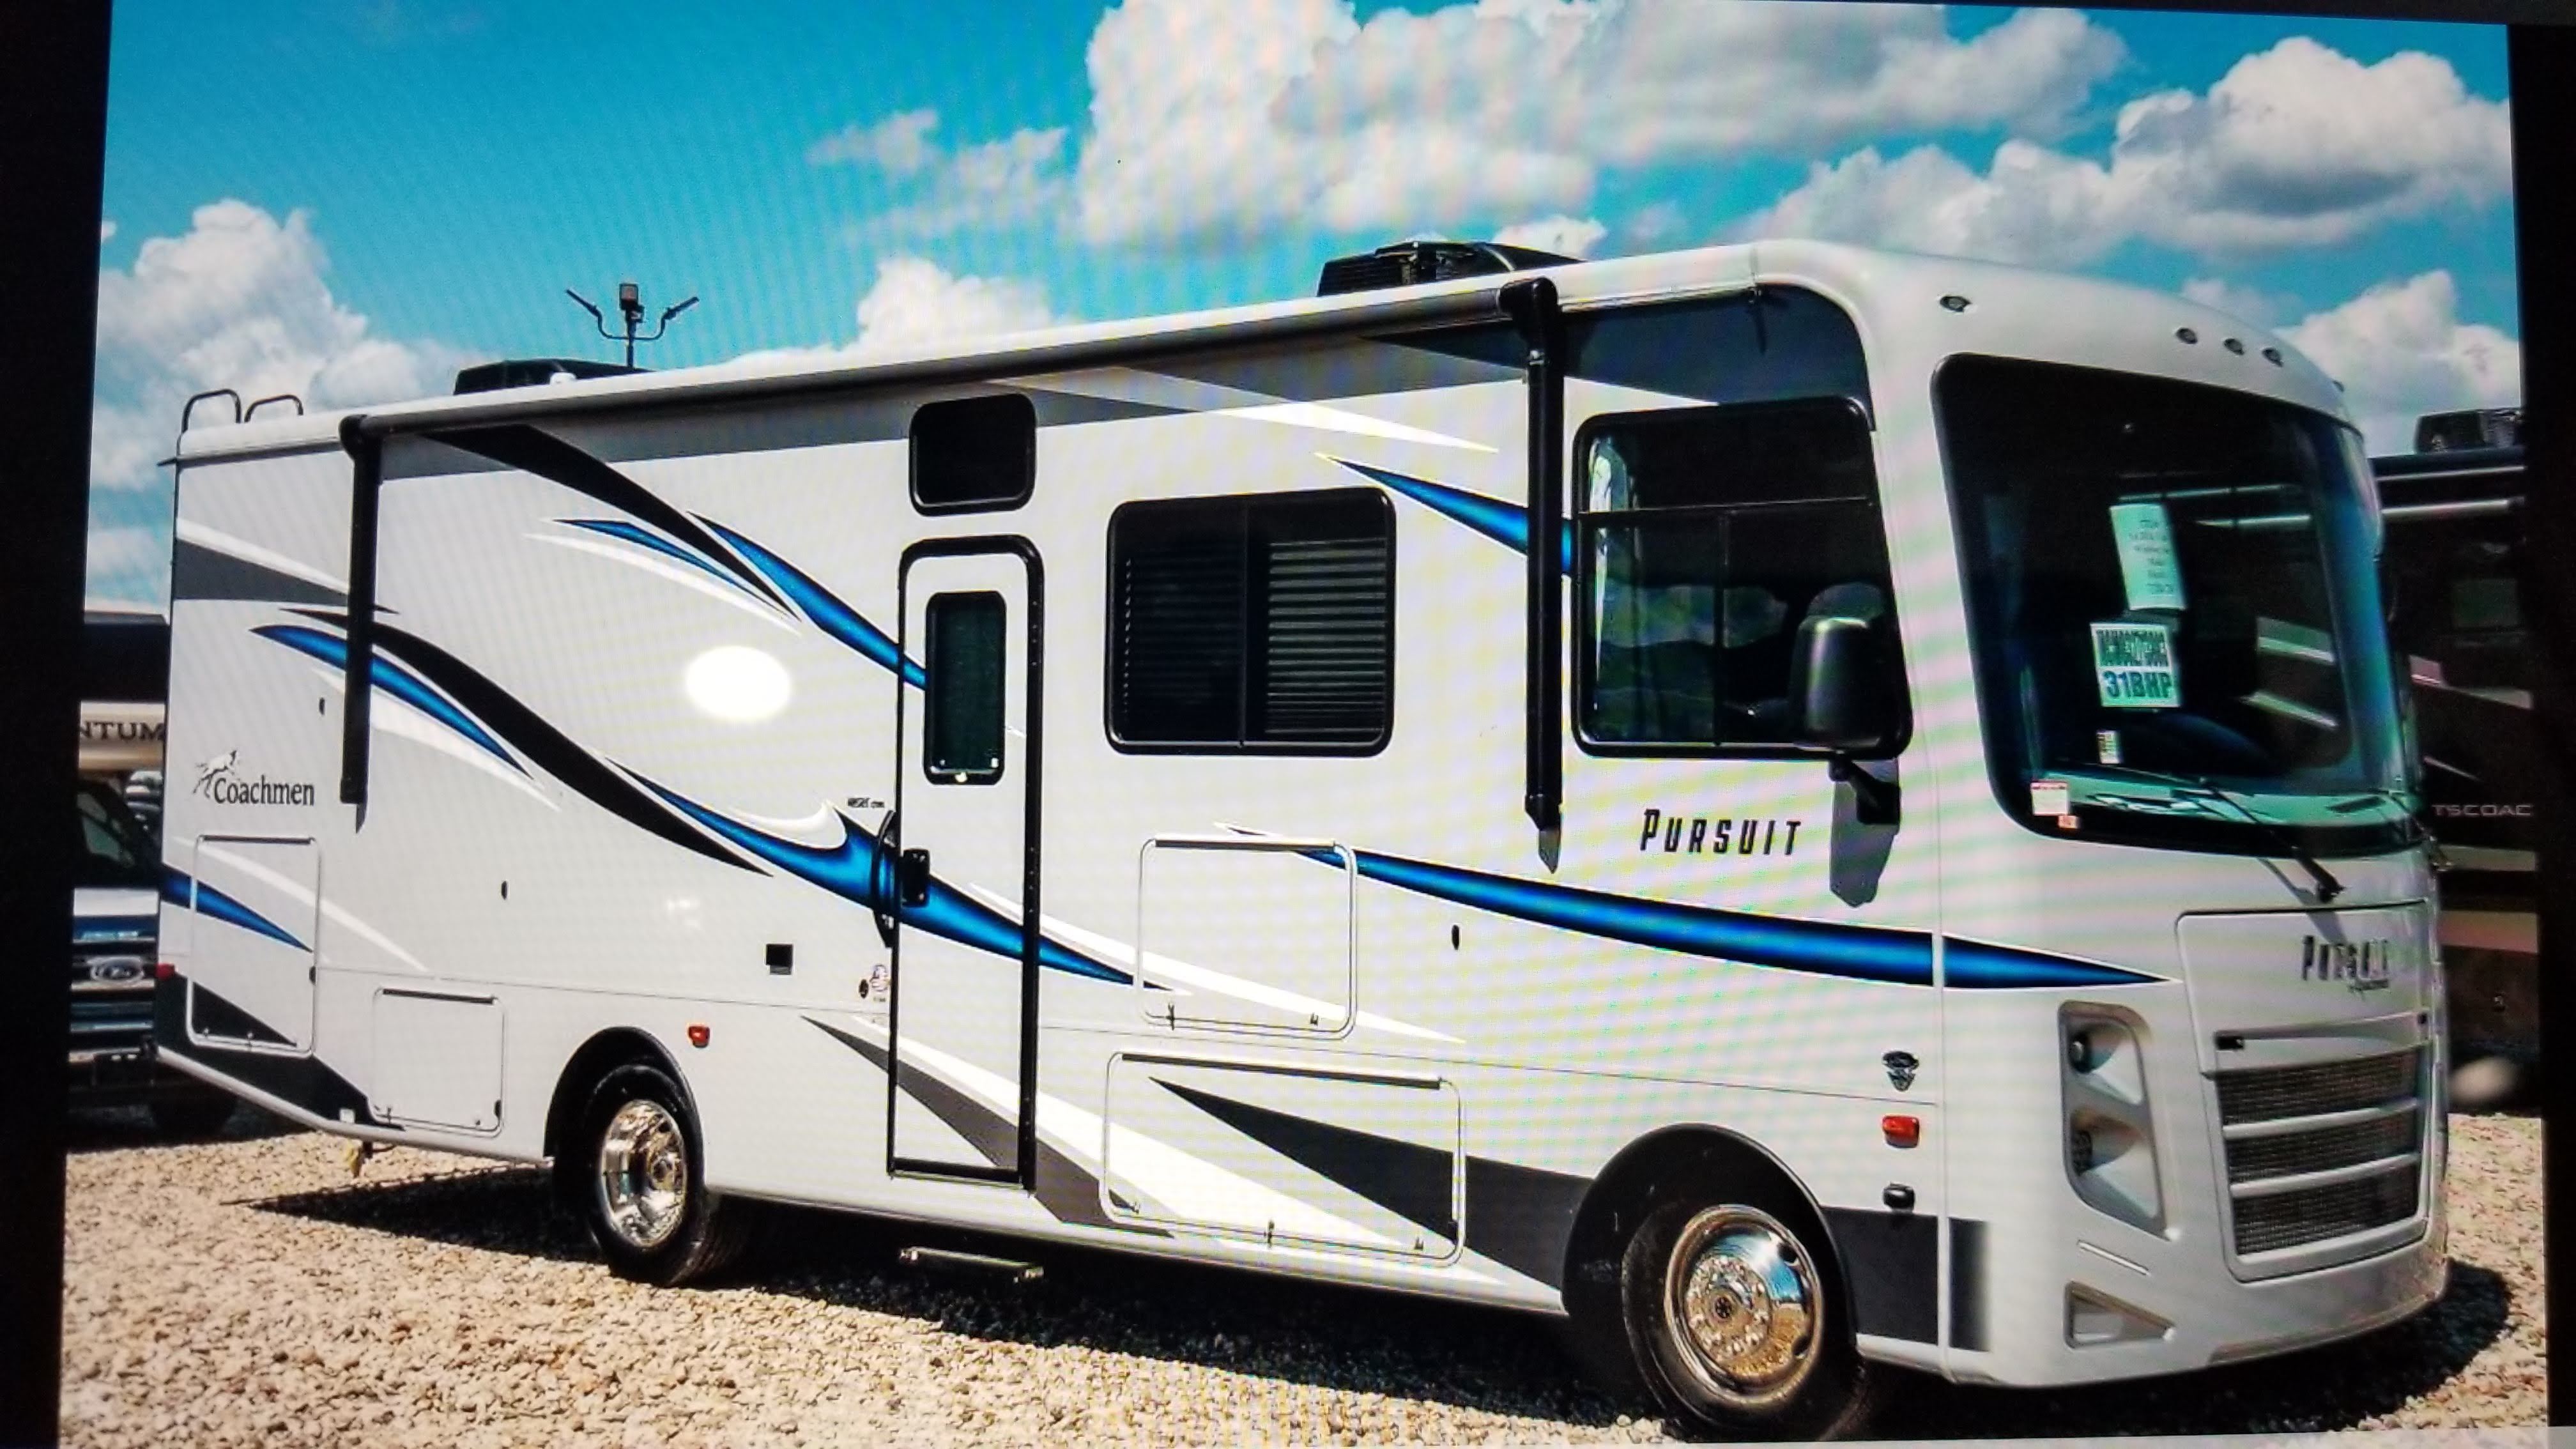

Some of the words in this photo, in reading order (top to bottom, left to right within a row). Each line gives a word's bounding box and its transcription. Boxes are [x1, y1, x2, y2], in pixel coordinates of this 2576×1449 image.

[2103, 671, 2172, 698] 31BHP
[214, 774, 315, 806] Coachmen
[1640, 808, 1802, 856] PURSUIT
